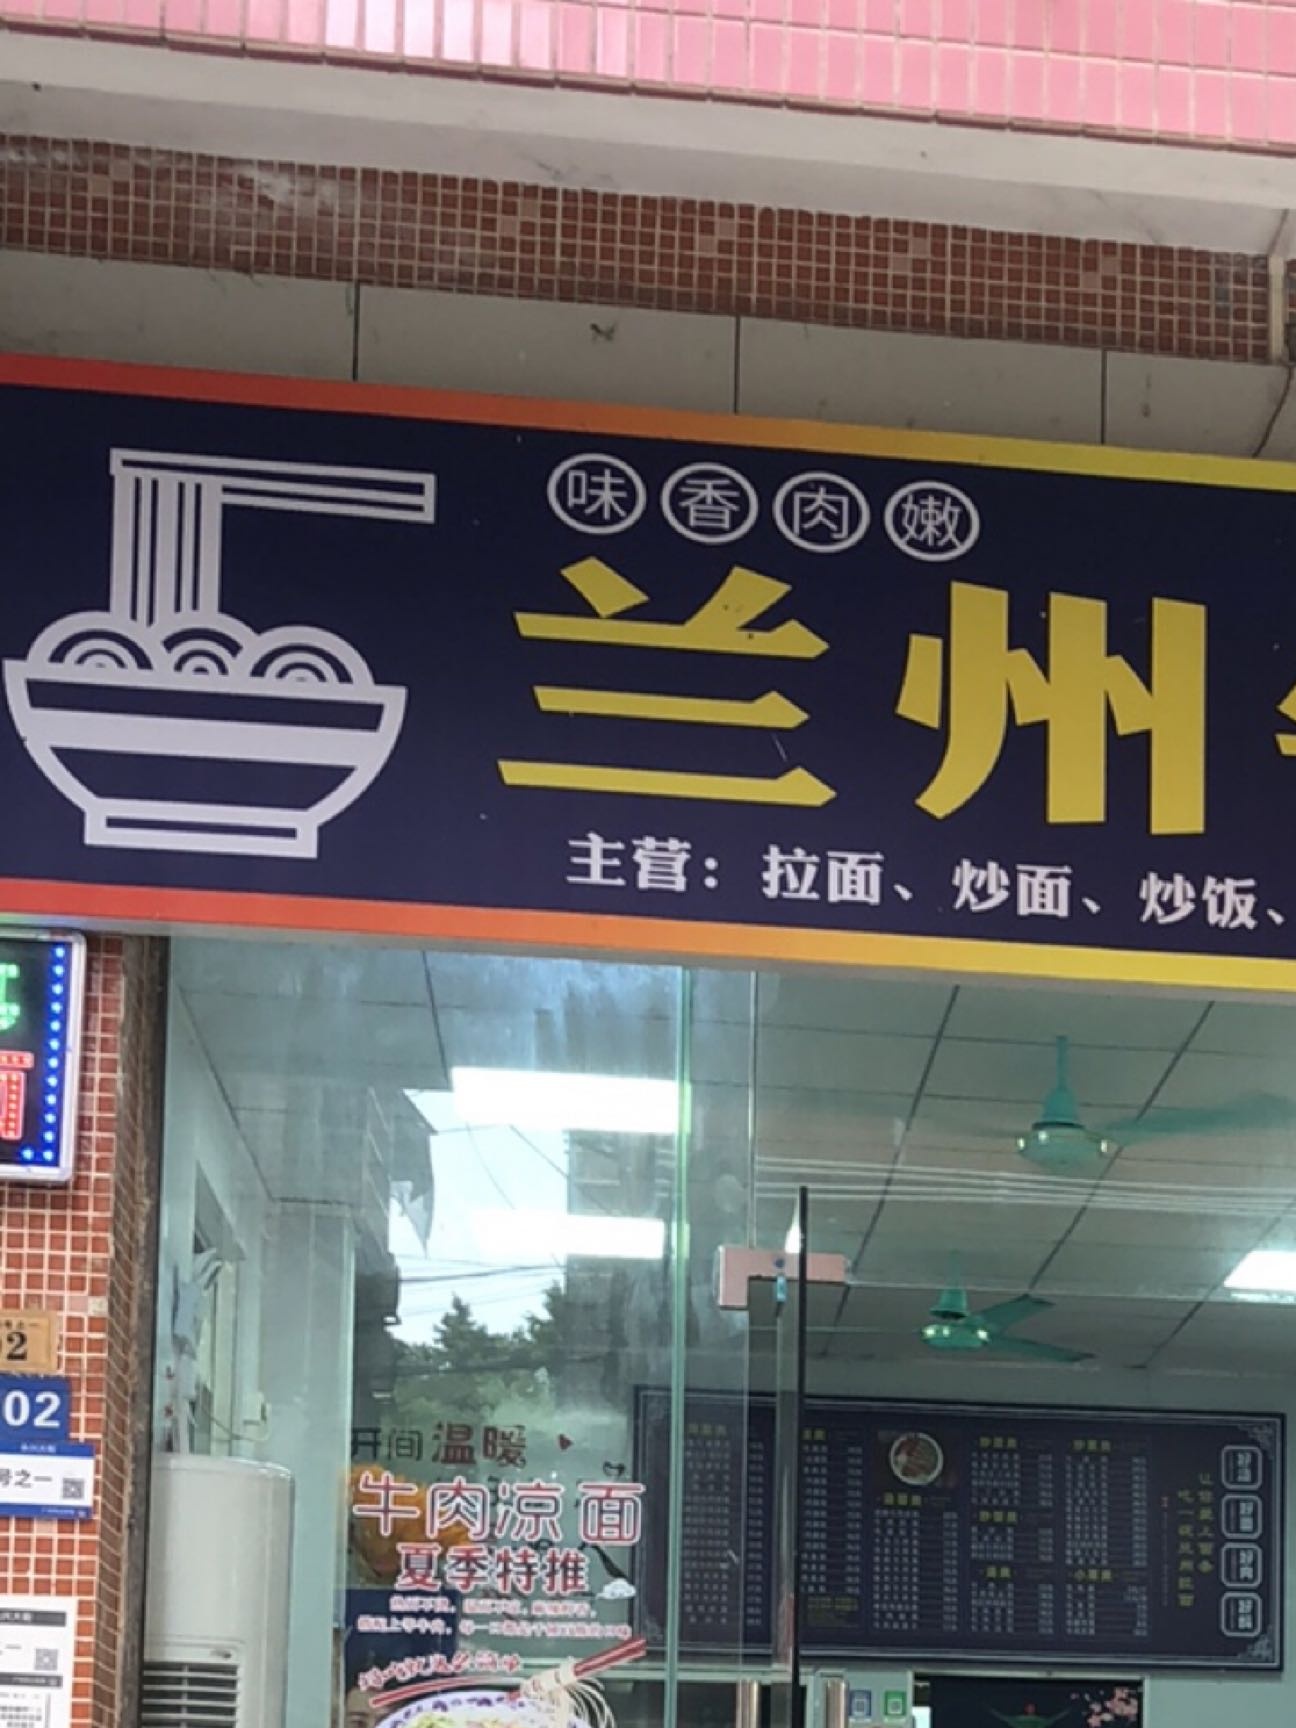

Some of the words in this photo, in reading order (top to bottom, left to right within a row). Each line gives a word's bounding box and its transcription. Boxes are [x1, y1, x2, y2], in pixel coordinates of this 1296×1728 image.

[563, 470, 962, 549] 味香肉嫩
[352, 1470, 647, 1546] 牛肉凉面
[395, 1541, 590, 1593] 夏季特推
